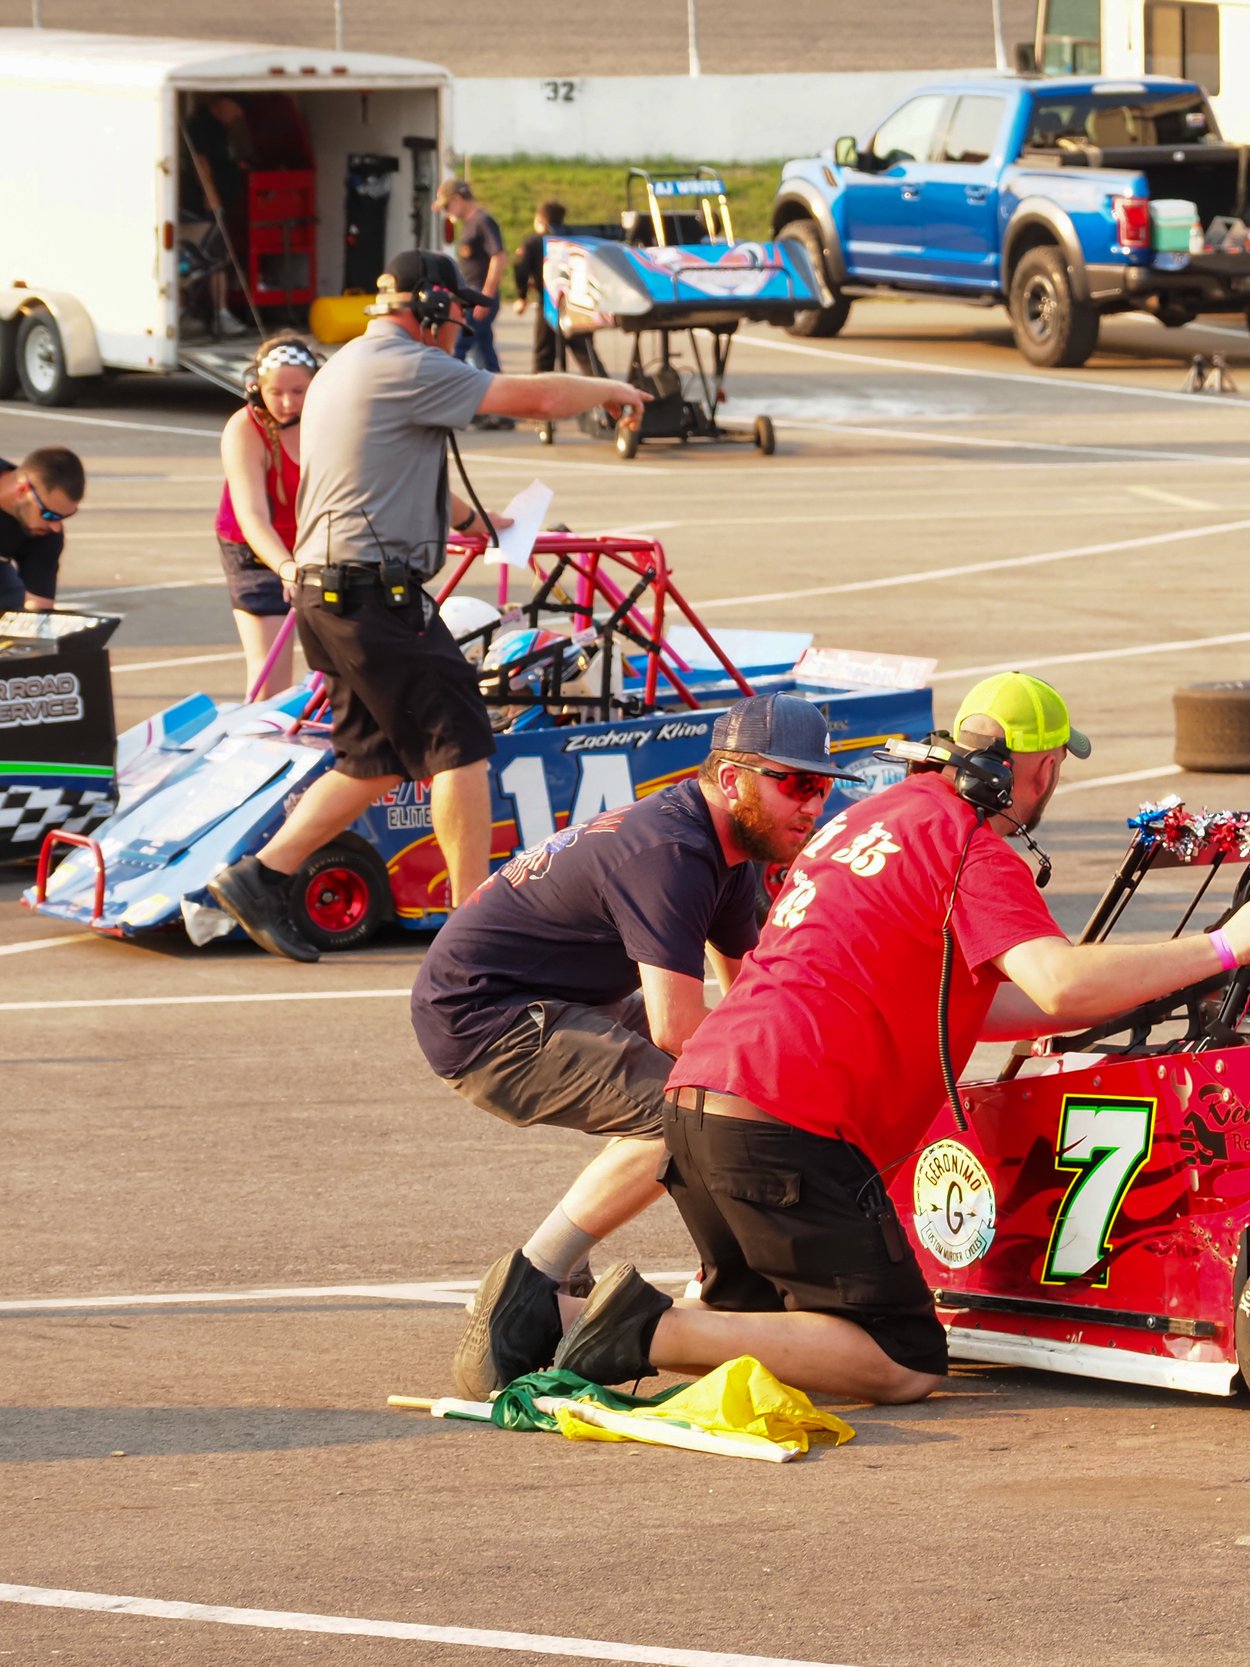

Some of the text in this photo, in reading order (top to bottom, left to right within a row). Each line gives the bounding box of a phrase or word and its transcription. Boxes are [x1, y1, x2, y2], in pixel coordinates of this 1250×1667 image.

[545, 81, 575, 102] 32
[9, 674, 77, 699] ROAD
[562, 721, 709, 752] Zachary Kline
[924, 1153, 982, 1192] GERONIMO
[1040, 1094, 1157, 1288] 7
[946, 1180, 964, 1235] G
[925, 1228, 944, 1257] CUSTOM
